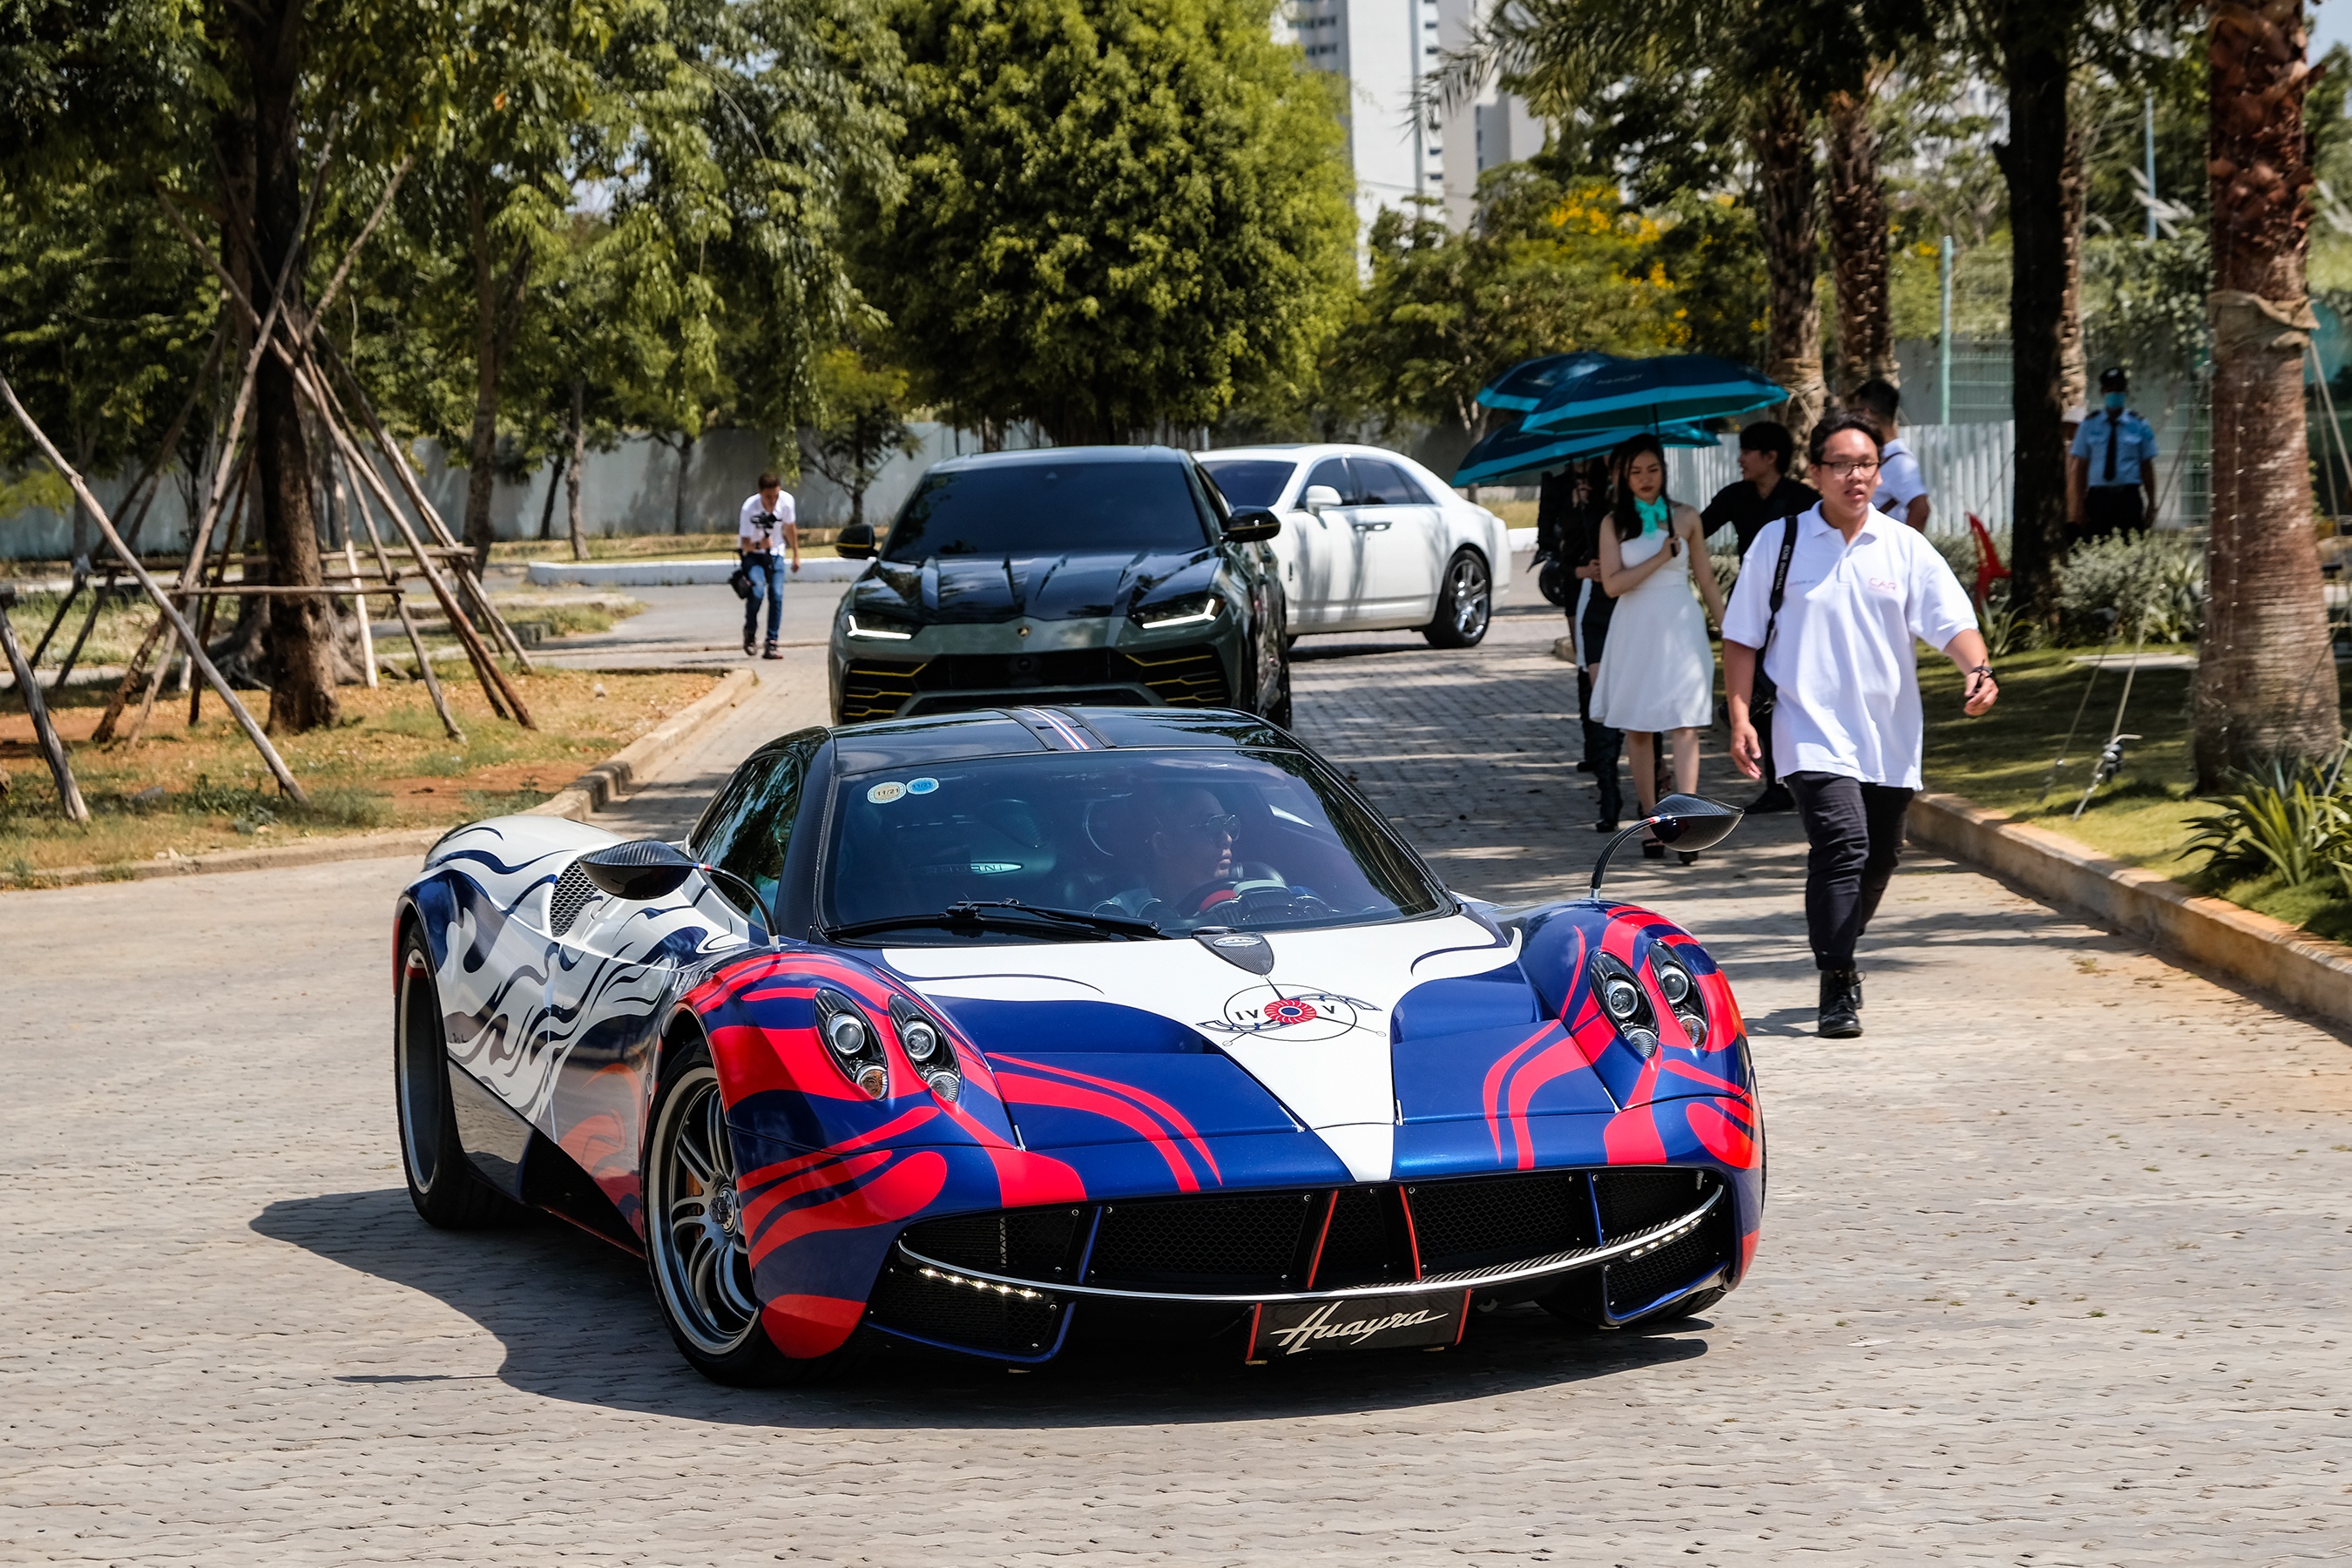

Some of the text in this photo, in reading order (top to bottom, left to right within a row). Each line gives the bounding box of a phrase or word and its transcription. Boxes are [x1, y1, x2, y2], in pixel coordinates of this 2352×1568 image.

[1235, 1004, 1335, 1021] IV V
[1269, 1300, 1449, 1355] Huayra
